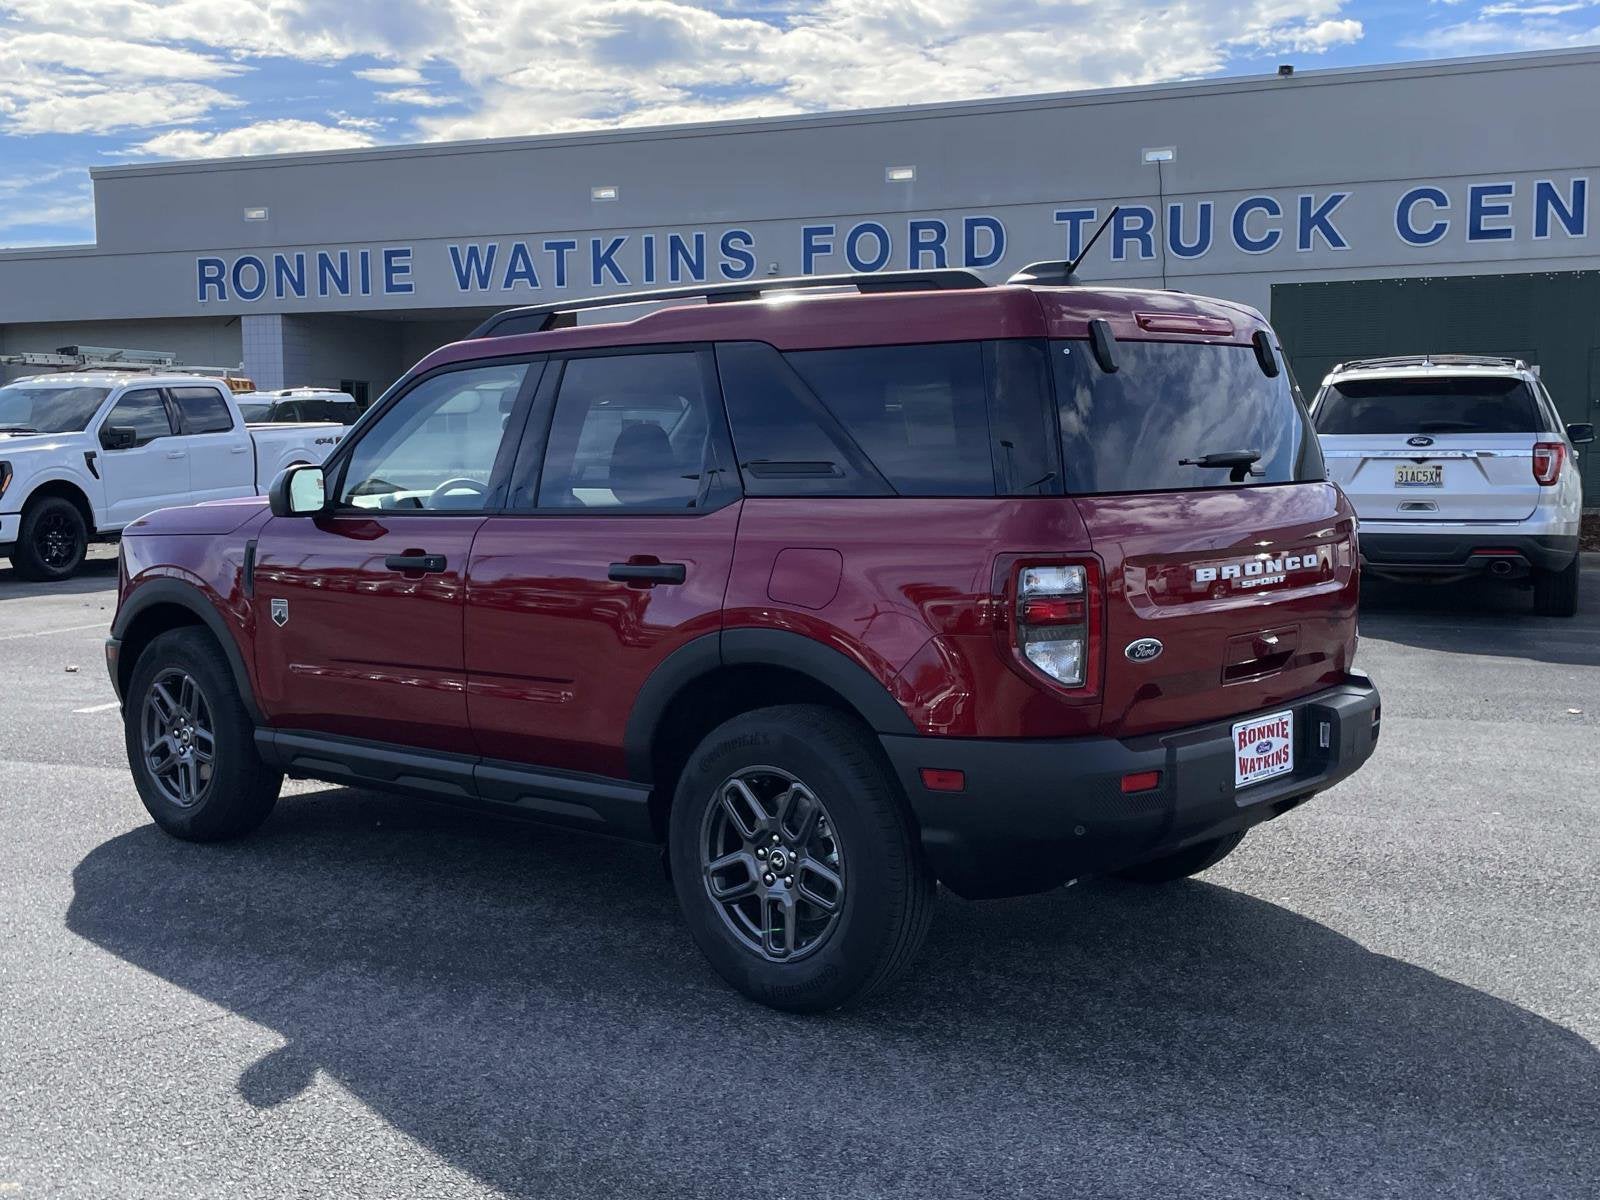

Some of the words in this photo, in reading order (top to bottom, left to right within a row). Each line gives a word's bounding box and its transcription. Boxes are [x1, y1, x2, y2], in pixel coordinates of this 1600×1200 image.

[197, 247, 415, 302] RONNIE
[447, 229, 757, 292] WATKINS
[801, 215, 1008, 275] FORD
[1053, 192, 1353, 261] TRUCK
[1394, 176, 1589, 247] CEN
[1195, 554, 1318, 582] BRONCO
[1241, 574, 1286, 588] SPORT
[1238, 721, 1289, 751] RONNIE
[1239, 744, 1289, 776] WATKINS
